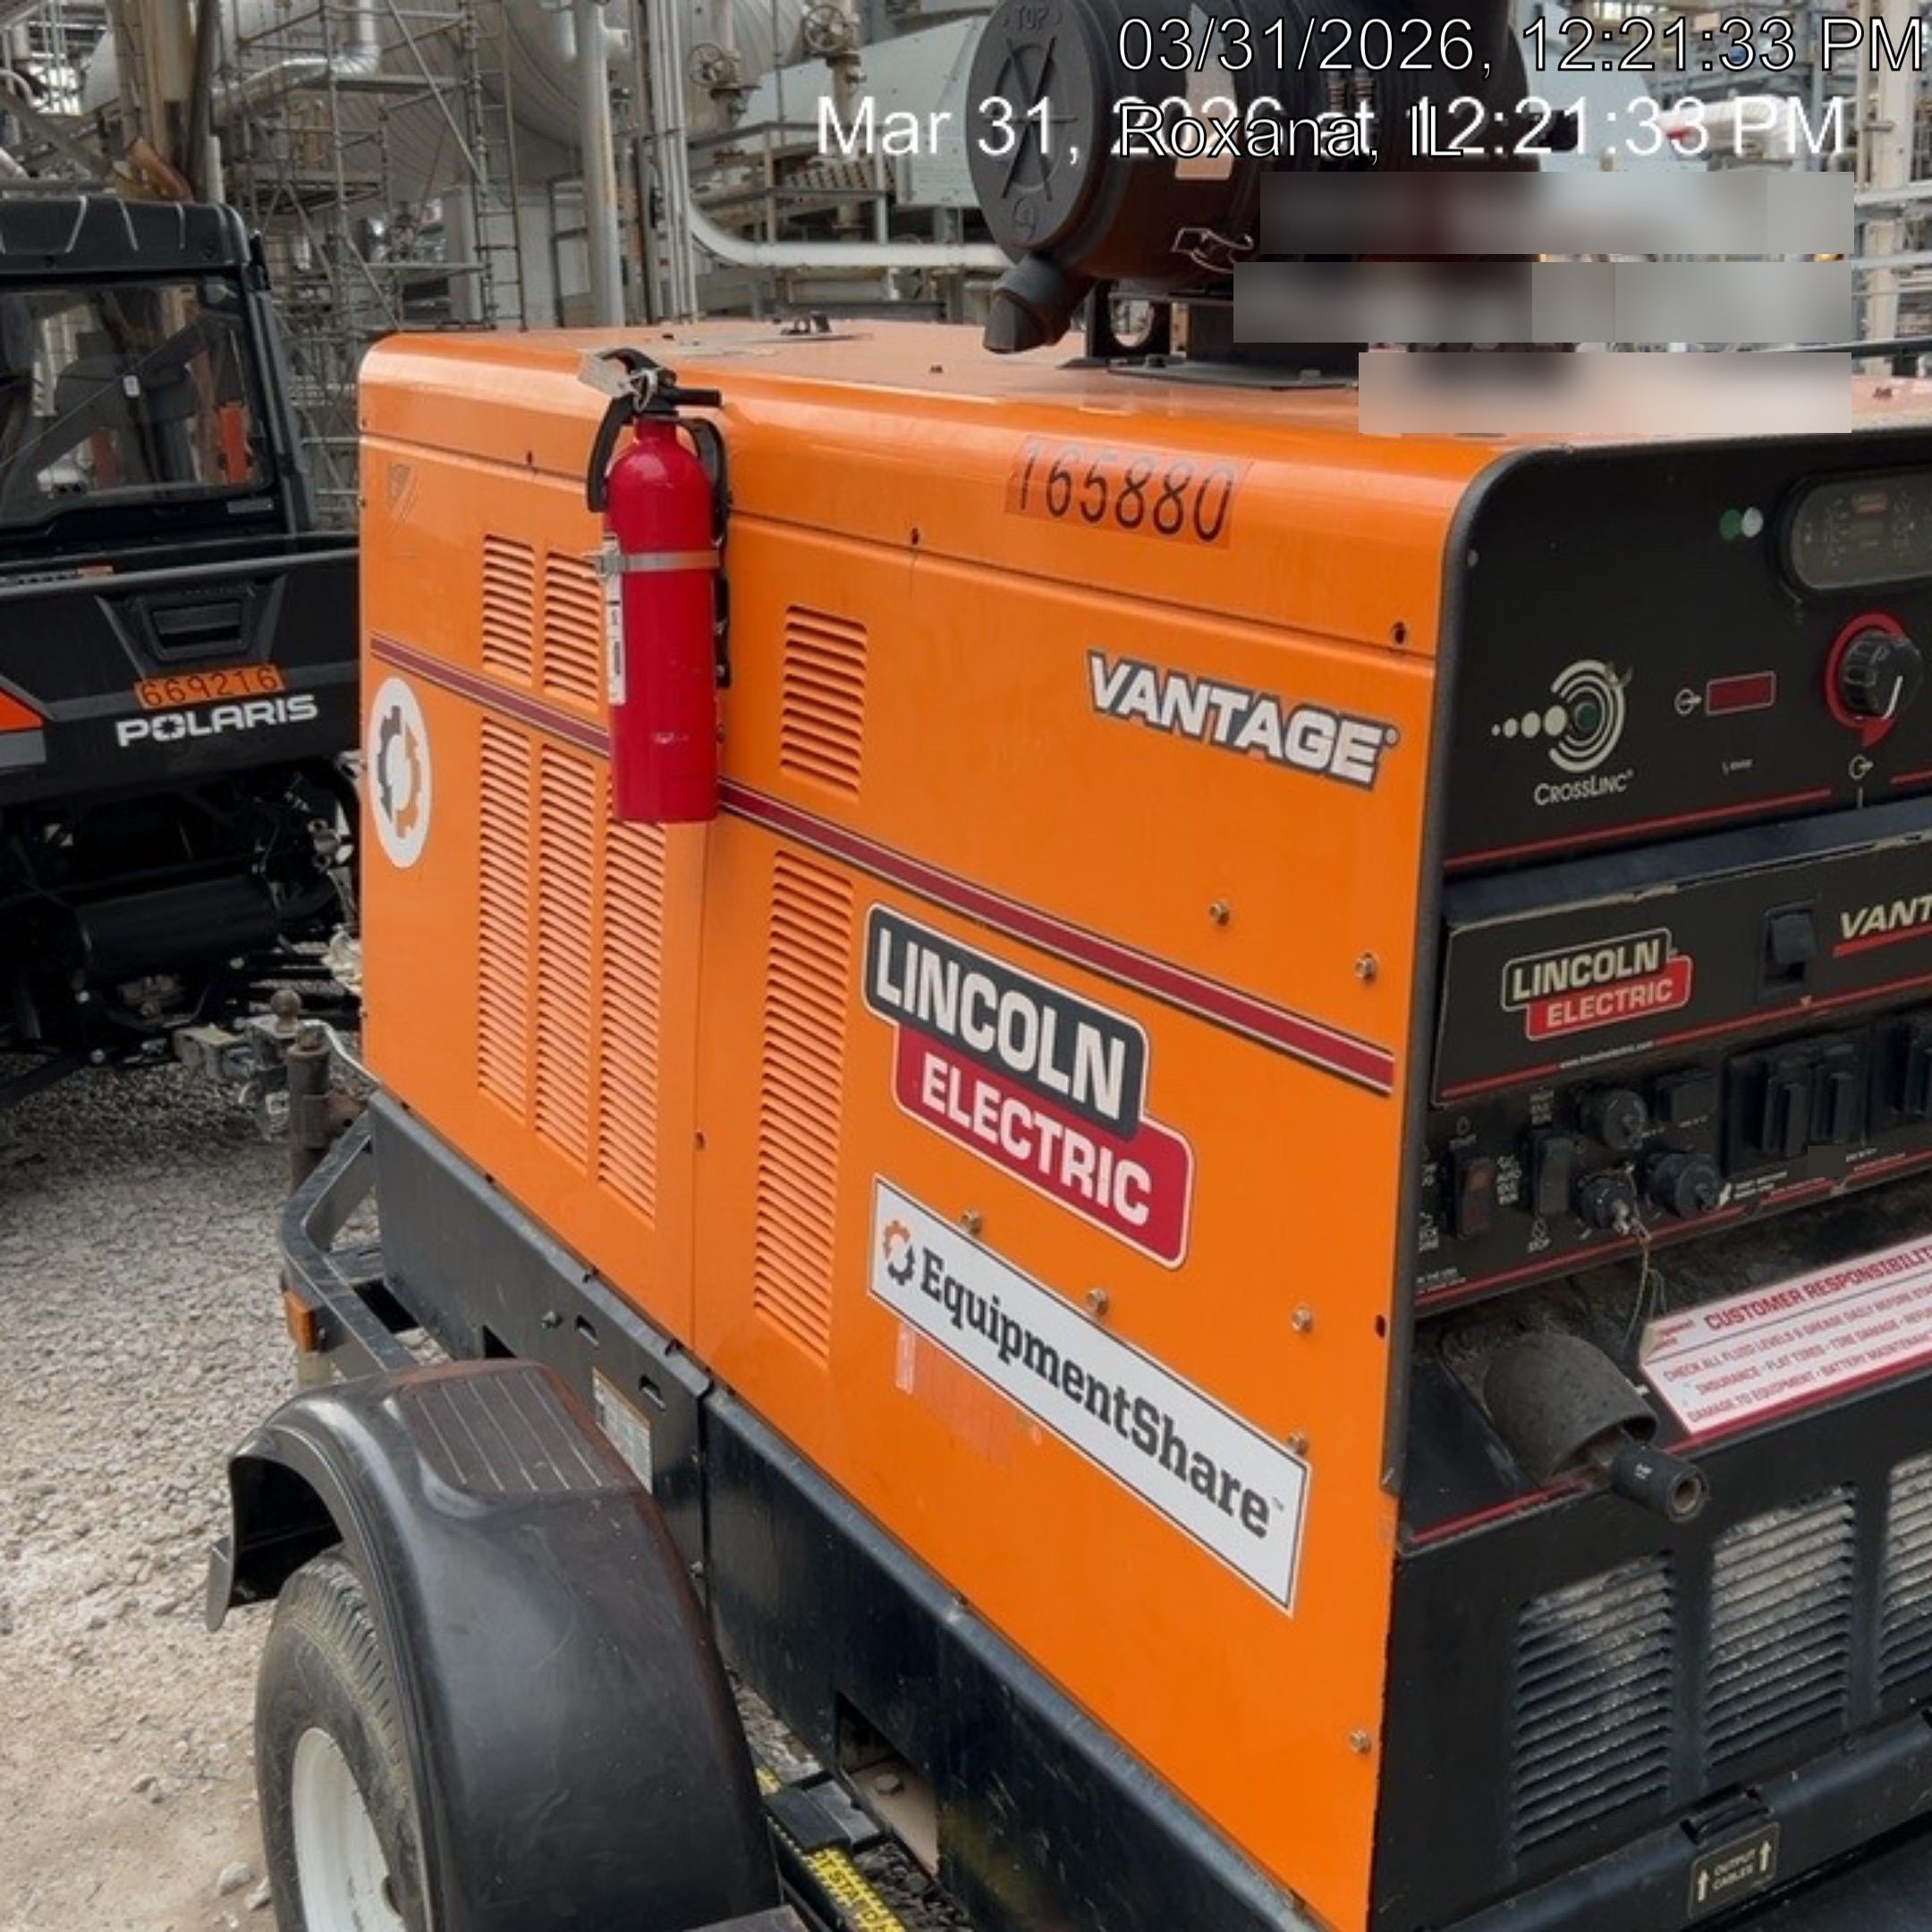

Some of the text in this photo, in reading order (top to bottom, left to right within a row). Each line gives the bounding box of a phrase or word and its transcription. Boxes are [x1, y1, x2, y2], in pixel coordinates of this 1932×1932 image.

[1019, 441, 1239, 542] 165880
[115, 694, 318, 747] POLARIS
[140, 666, 279, 707] 669216
[1088, 650, 1385, 788] VANTAGE
[1513, 938, 1660, 1001] LINCOLN
[1546, 979, 1674, 1028] ELECTRIC
[876, 928, 1125, 1121] LINCOLN
[921, 1053, 1153, 1228] ELECTRIC
[1704, 1287, 1805, 1330] CUSTOMER
[920, 1247, 1271, 1539] EquipmentShare
